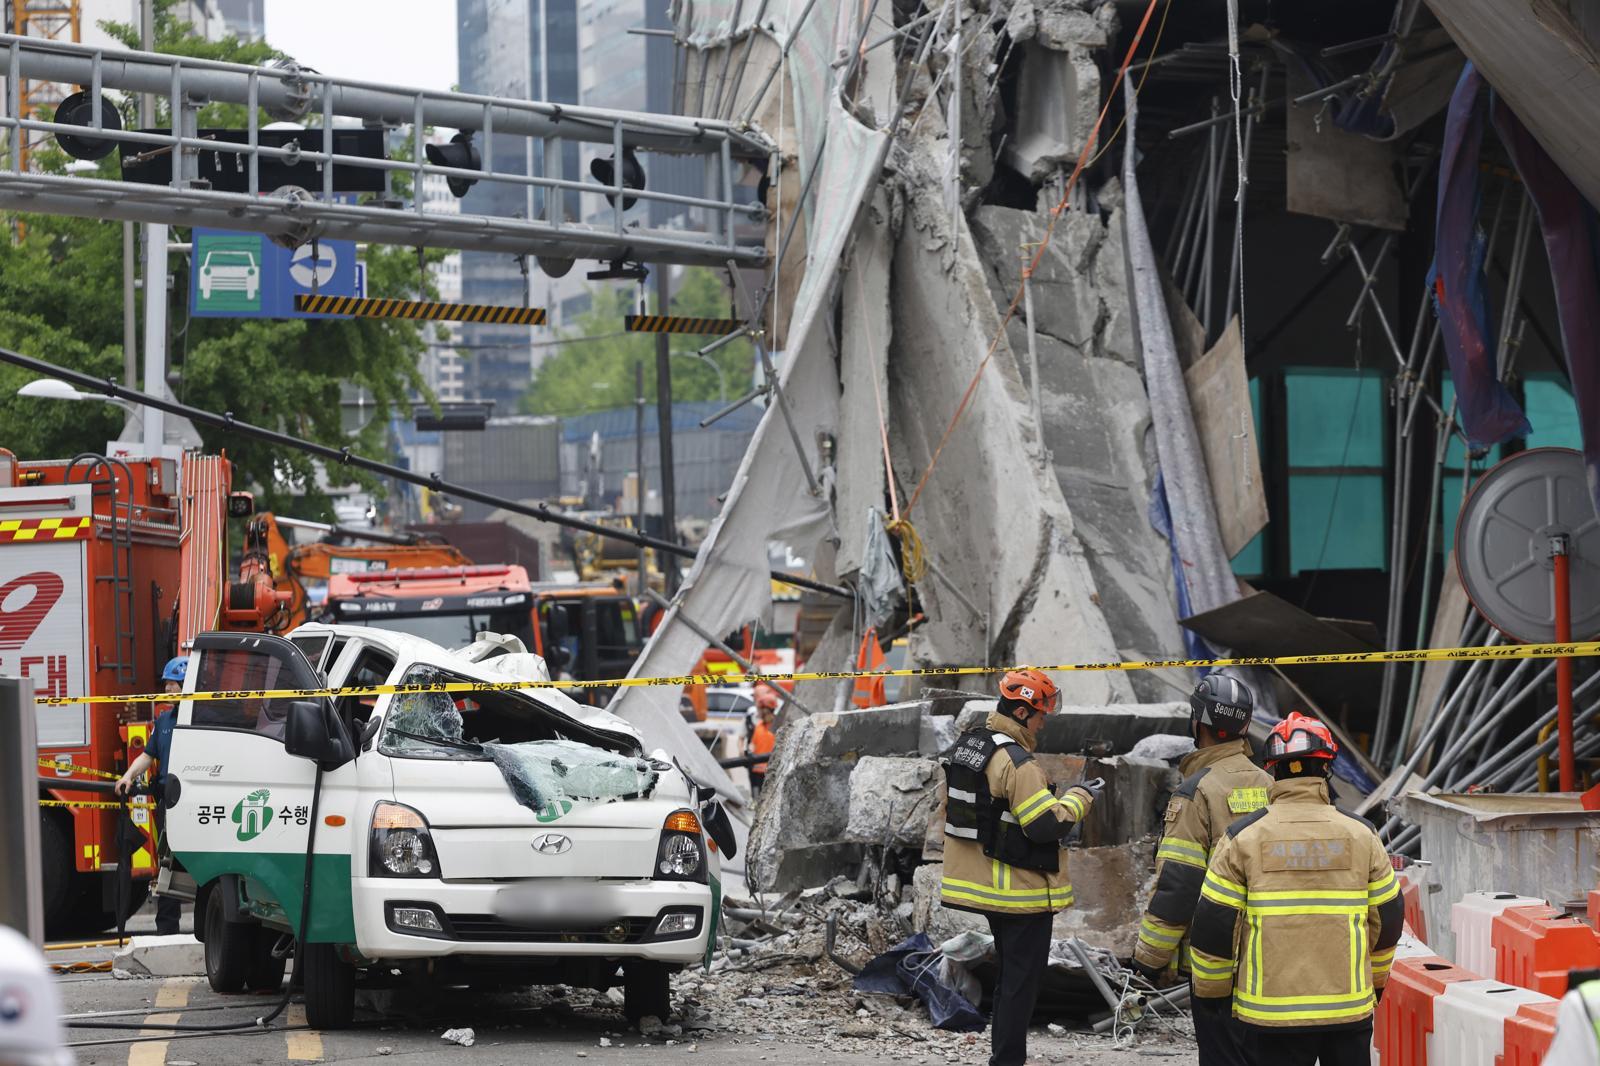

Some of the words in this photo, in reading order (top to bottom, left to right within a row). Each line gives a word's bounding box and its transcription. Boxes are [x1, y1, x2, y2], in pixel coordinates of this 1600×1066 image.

[1215, 702, 1235, 717] Seoul
[1235, 708, 1247, 720] fire
[197, 805, 227, 825] 공무
[278, 805, 309, 826] 수행
